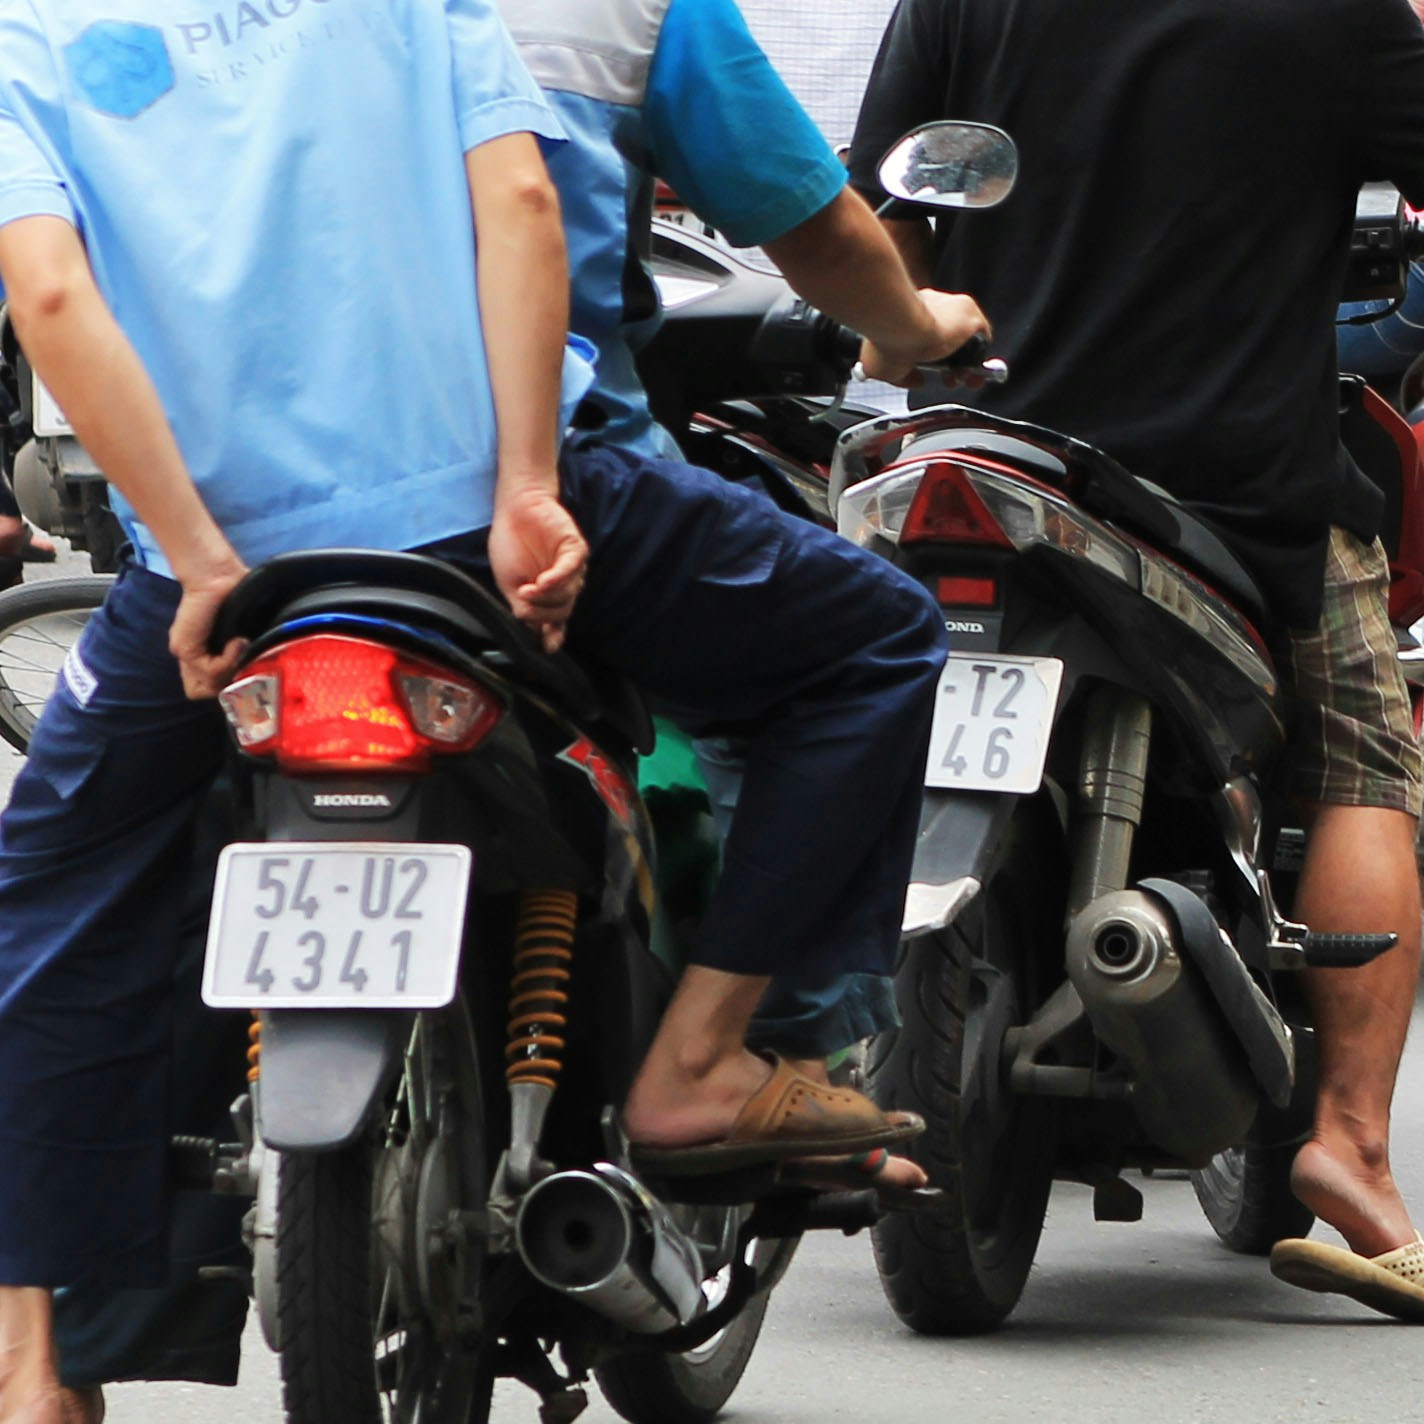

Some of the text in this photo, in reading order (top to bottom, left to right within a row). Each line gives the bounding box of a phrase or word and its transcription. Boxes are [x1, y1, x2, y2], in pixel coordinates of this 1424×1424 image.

[313, 794, 392, 807] HONDA
[254, 858, 430, 922] 54-U2
[243, 930, 412, 994] 4341
